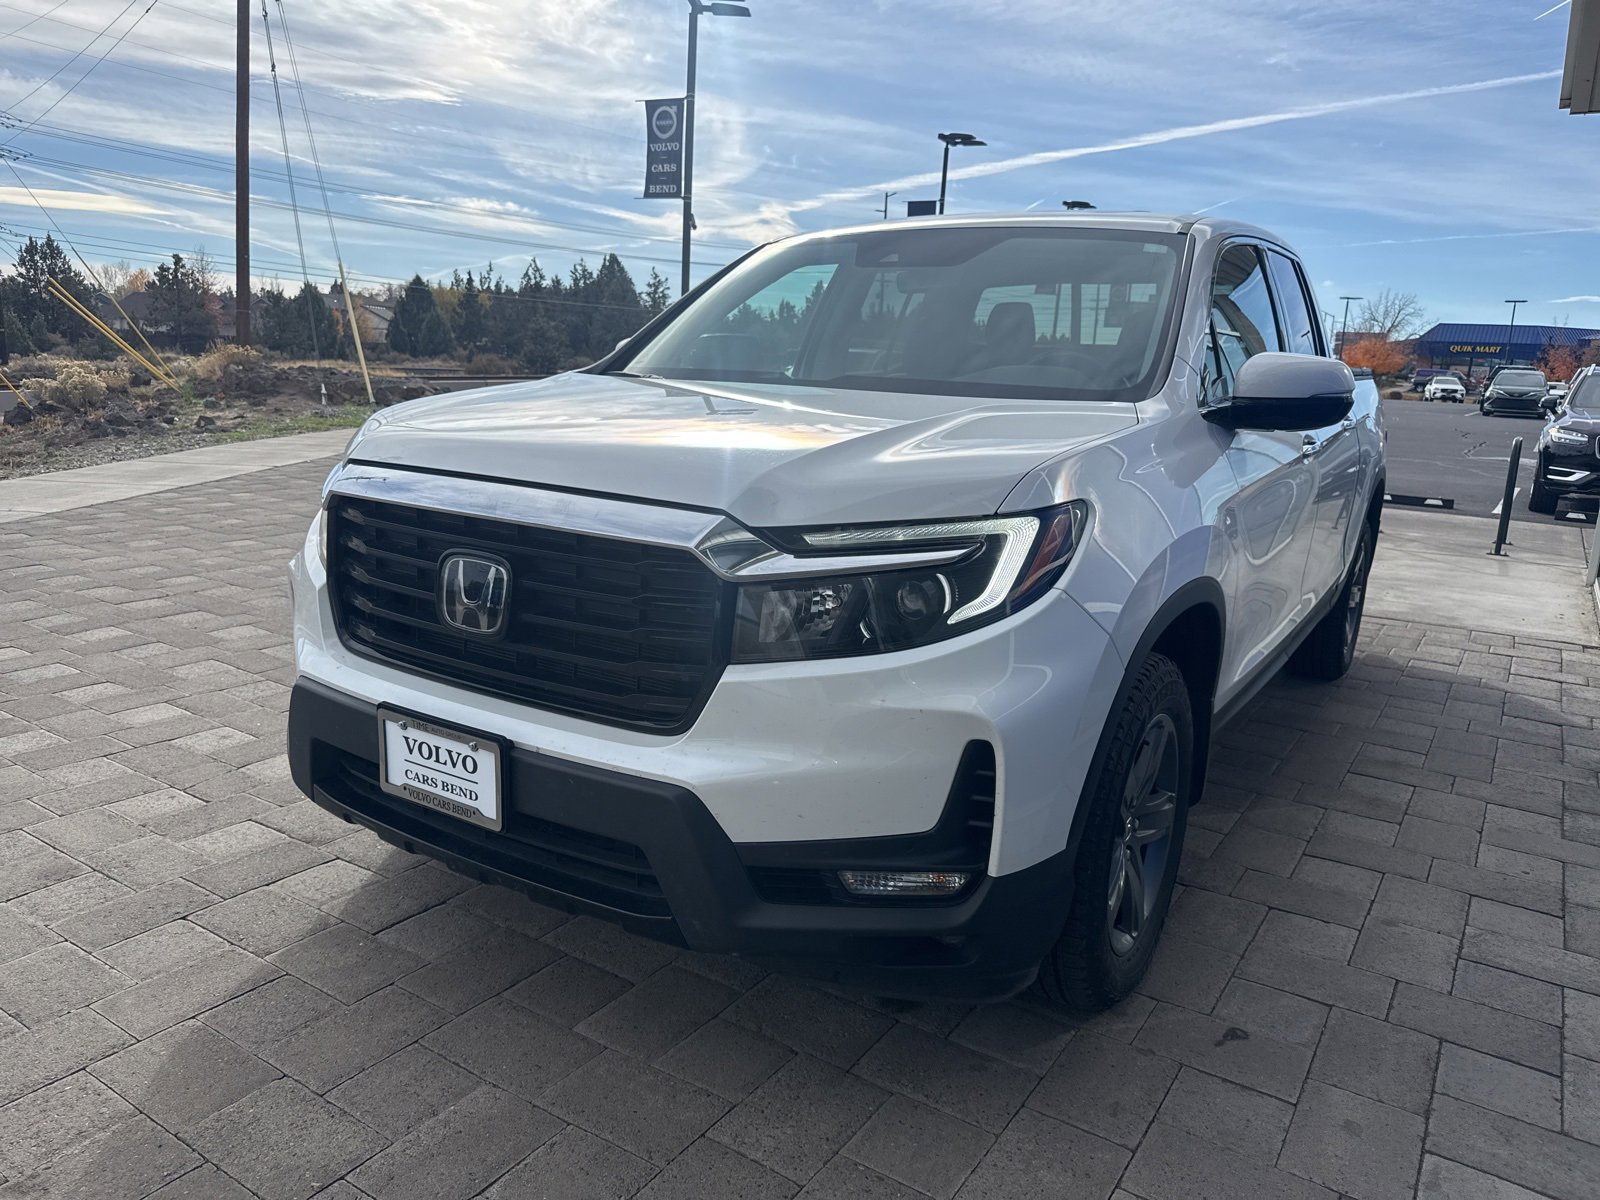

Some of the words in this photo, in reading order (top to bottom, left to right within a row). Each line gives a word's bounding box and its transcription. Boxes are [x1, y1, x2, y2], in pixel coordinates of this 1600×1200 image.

[649, 142, 679, 152] VOLVO
[651, 163, 677, 173] CARS
[648, 184, 677, 193] BEND
[1449, 345, 1472, 353] QUIK
[1475, 345, 1502, 353] MART
[411, 719, 430, 732] TIME
[402, 735, 478, 775] VOLVO
[404, 769, 438, 788] CARS
[440, 780, 479, 802] BEND
[408, 788, 432, 804] VOLVO
[432, 798, 451, 813] CARS
[452, 804, 472, 819] BEND
